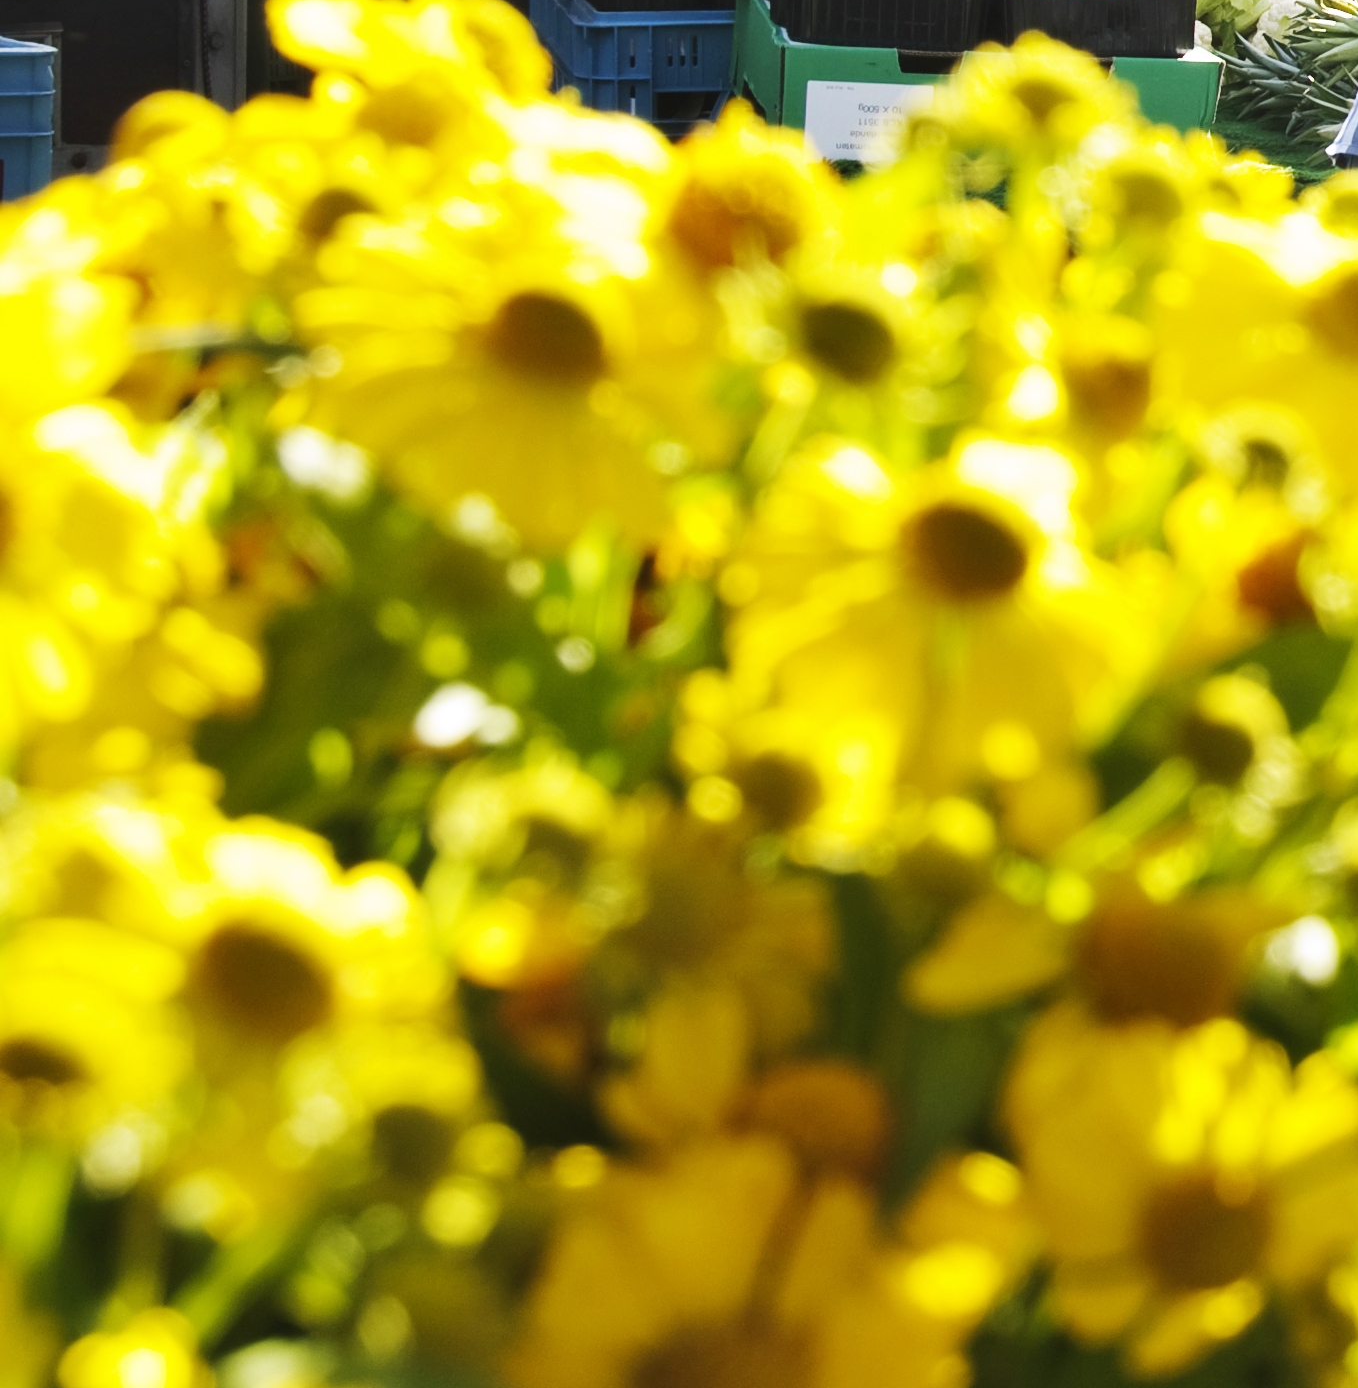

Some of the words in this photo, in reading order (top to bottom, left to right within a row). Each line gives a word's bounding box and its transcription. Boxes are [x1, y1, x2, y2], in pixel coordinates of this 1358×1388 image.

[857, 103, 880, 114] 500g
[892, 106, 902, 114] 10
[858, 118, 879, 126] 3511
